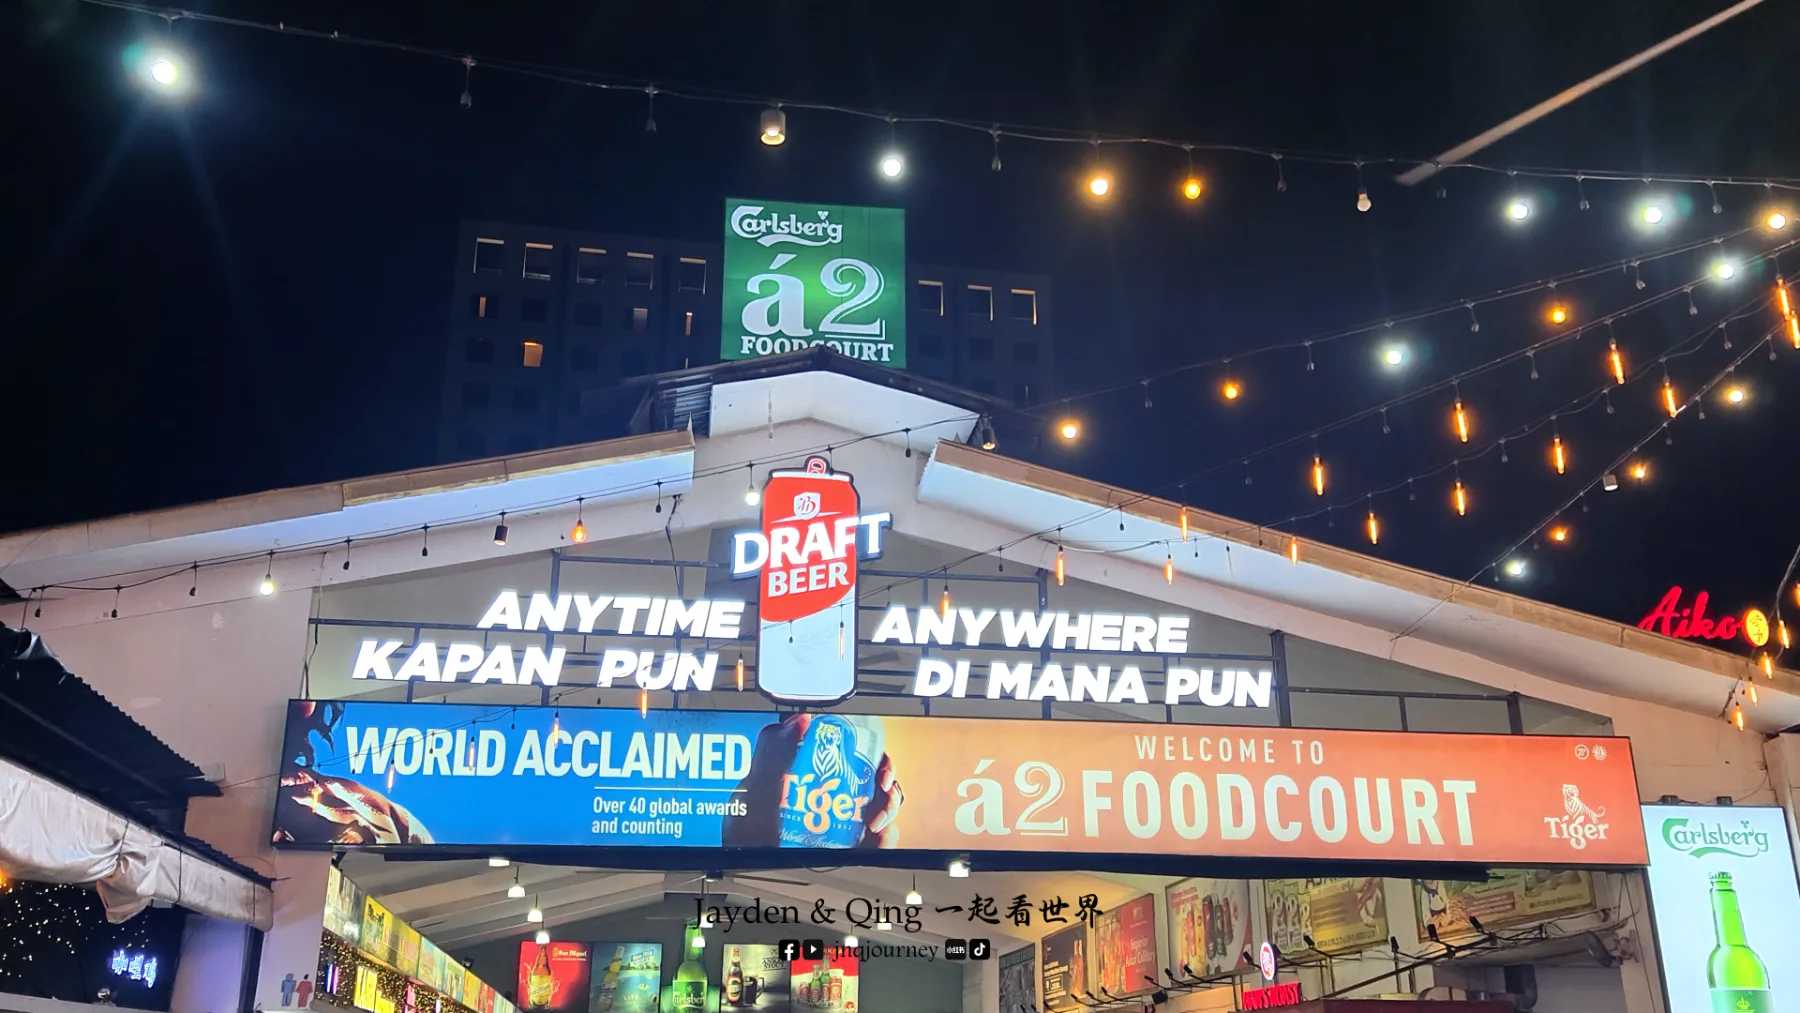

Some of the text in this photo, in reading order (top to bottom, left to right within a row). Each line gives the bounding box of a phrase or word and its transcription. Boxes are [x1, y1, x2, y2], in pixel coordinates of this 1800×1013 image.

[730, 205, 843, 247] Carlsberg
[734, 512, 891, 574] DRAFT
[768, 562, 849, 597] BEER
[476, 588, 746, 638] ANYTIME
[871, 605, 1191, 654] ANYWHERE
[1637, 585, 1742, 640] Aiko
[352, 637, 720, 692] KAPAN PUN
[913, 658, 1273, 708] DI MANA PUN
[345, 726, 752, 781] WORLD ACCLAIMED
[1134, 734, 1324, 765] WELCOME TO
[592, 818, 683, 839] and counting
[593, 796, 748, 821] Over 40 global awards
[778, 773, 869, 835] Tiger
[1081, 769, 1477, 847] FOODCOURT
[1543, 814, 1609, 850] Tiger
[1661, 818, 1769, 859] Carlsberg
